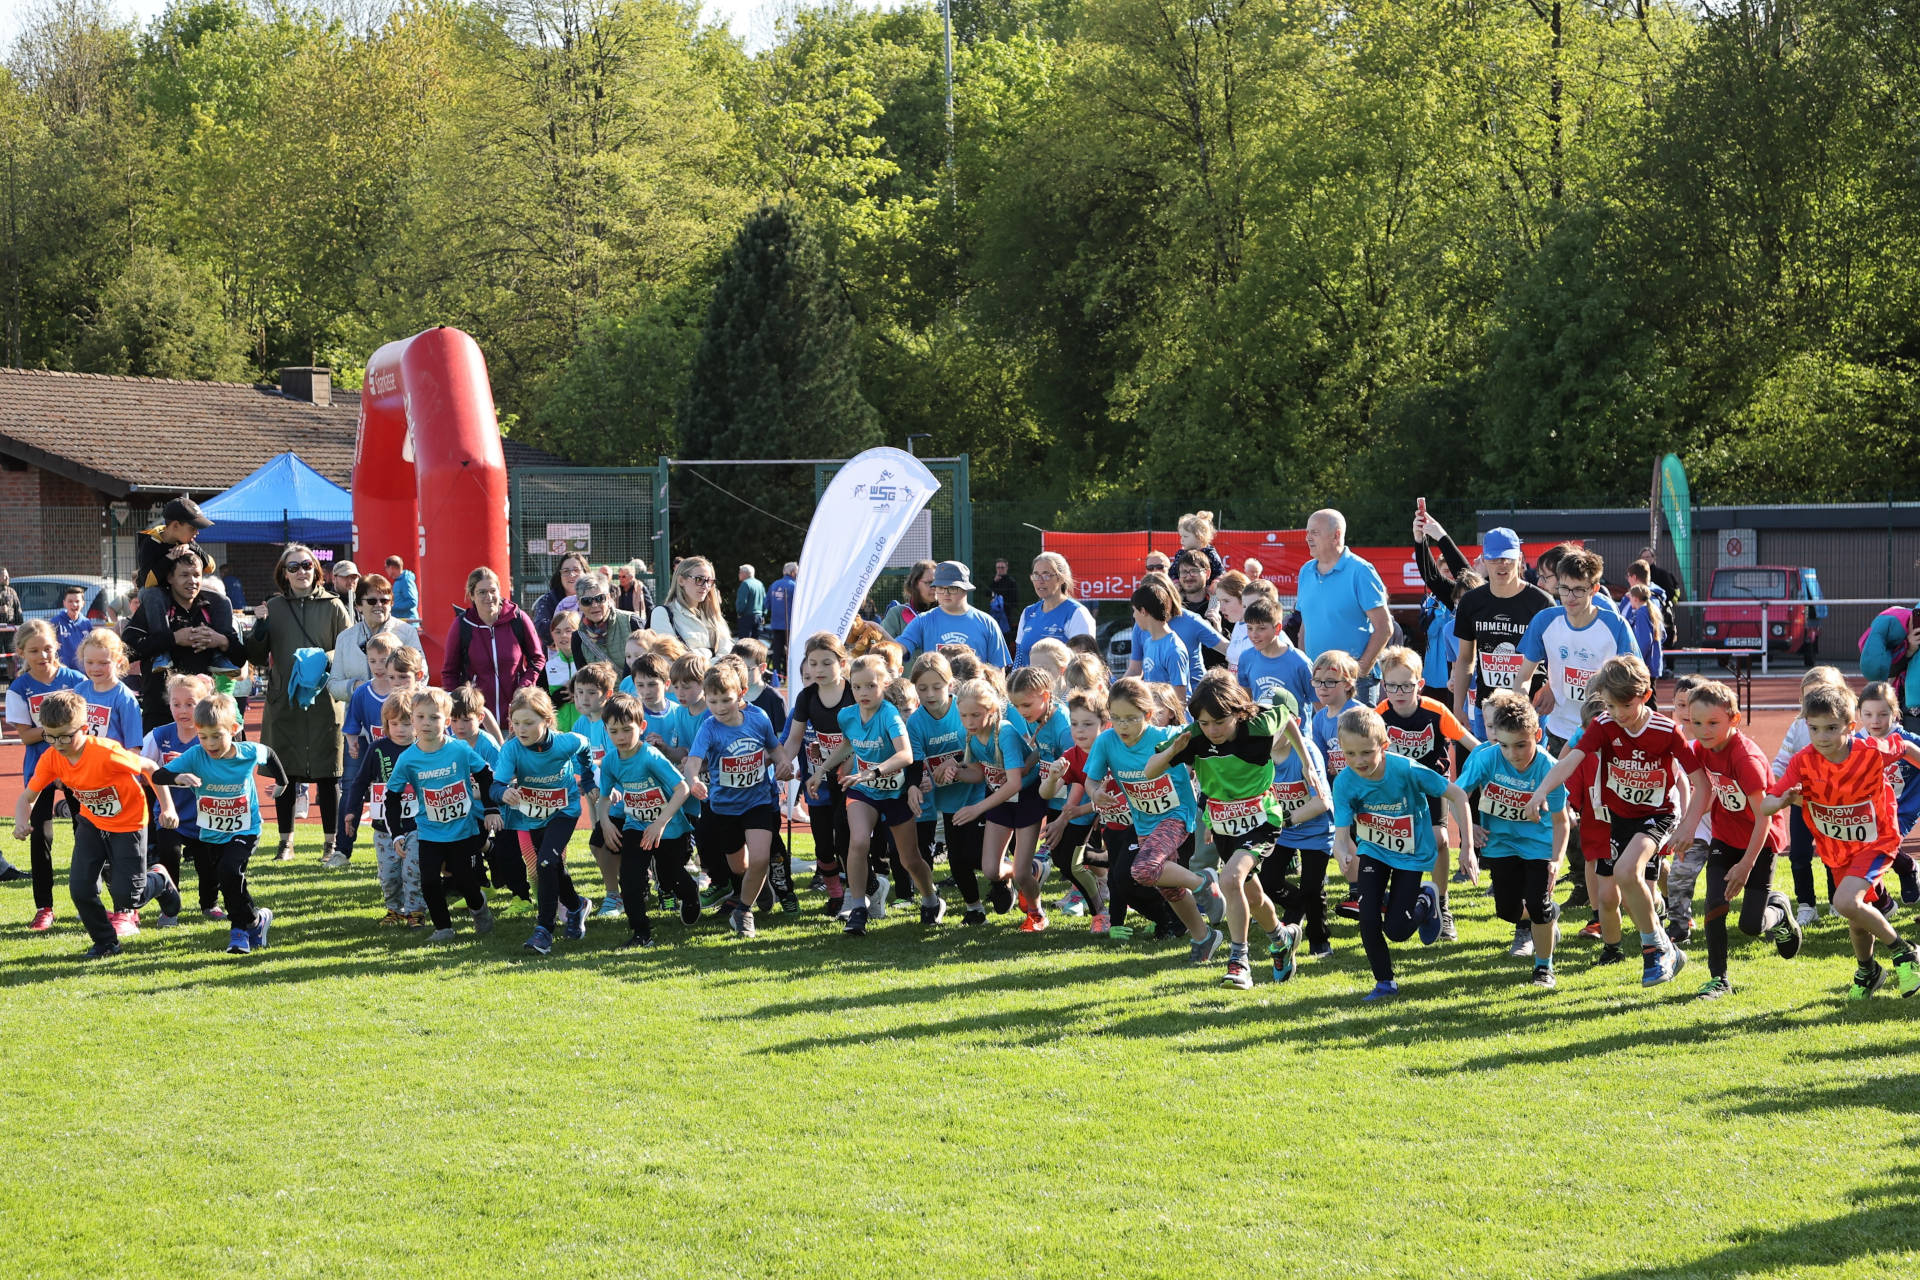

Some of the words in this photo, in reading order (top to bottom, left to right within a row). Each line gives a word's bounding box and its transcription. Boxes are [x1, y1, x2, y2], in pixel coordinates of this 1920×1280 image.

[869, 486, 897, 501] WSG
[1475, 621, 1529, 634] FIRMENLAU
[941, 631, 969, 644] WSG
[1491, 655, 1511, 663] new
[1482, 662, 1521, 673] balance
[1566, 674, 1588, 686] bala
[1570, 686, 1586, 700] 12
[1390, 734, 1432, 747] balance
[1400, 732, 1423, 740] new
[727, 738, 761, 755] WSG
[736, 754, 755, 764] new
[1632, 750, 1646, 760] SC
[724, 759, 762, 773] balance
[730, 770, 760, 787] 1202
[1118, 770, 1146, 779] ENNER
[1612, 772, 1661, 789] balance
[1624, 771, 1650, 780] new
[434, 786, 453, 798] new
[1132, 782, 1156, 791] new
[77, 794, 114, 805] alance
[426, 792, 466, 807] balance
[522, 794, 564, 806] balance
[532, 790, 553, 798] new
[1486, 788, 1529, 808] balanc
[1498, 787, 1524, 800] new
[1616, 783, 1655, 804] 1302
[86, 802, 114, 817] 252
[202, 805, 246, 816] balance
[212, 800, 235, 808] new
[1136, 796, 1171, 814] 1215
[1224, 803, 1246, 811] new
[434, 802, 467, 822] 1232
[1214, 805, 1258, 820] balance
[1815, 810, 1870, 826] balance
[1827, 807, 1854, 816] new
[208, 815, 244, 832] 1225
[1222, 815, 1260, 835] 1244
[1372, 816, 1396, 827] new
[1823, 822, 1867, 842] 1210
[1368, 828, 1405, 852] 1219
